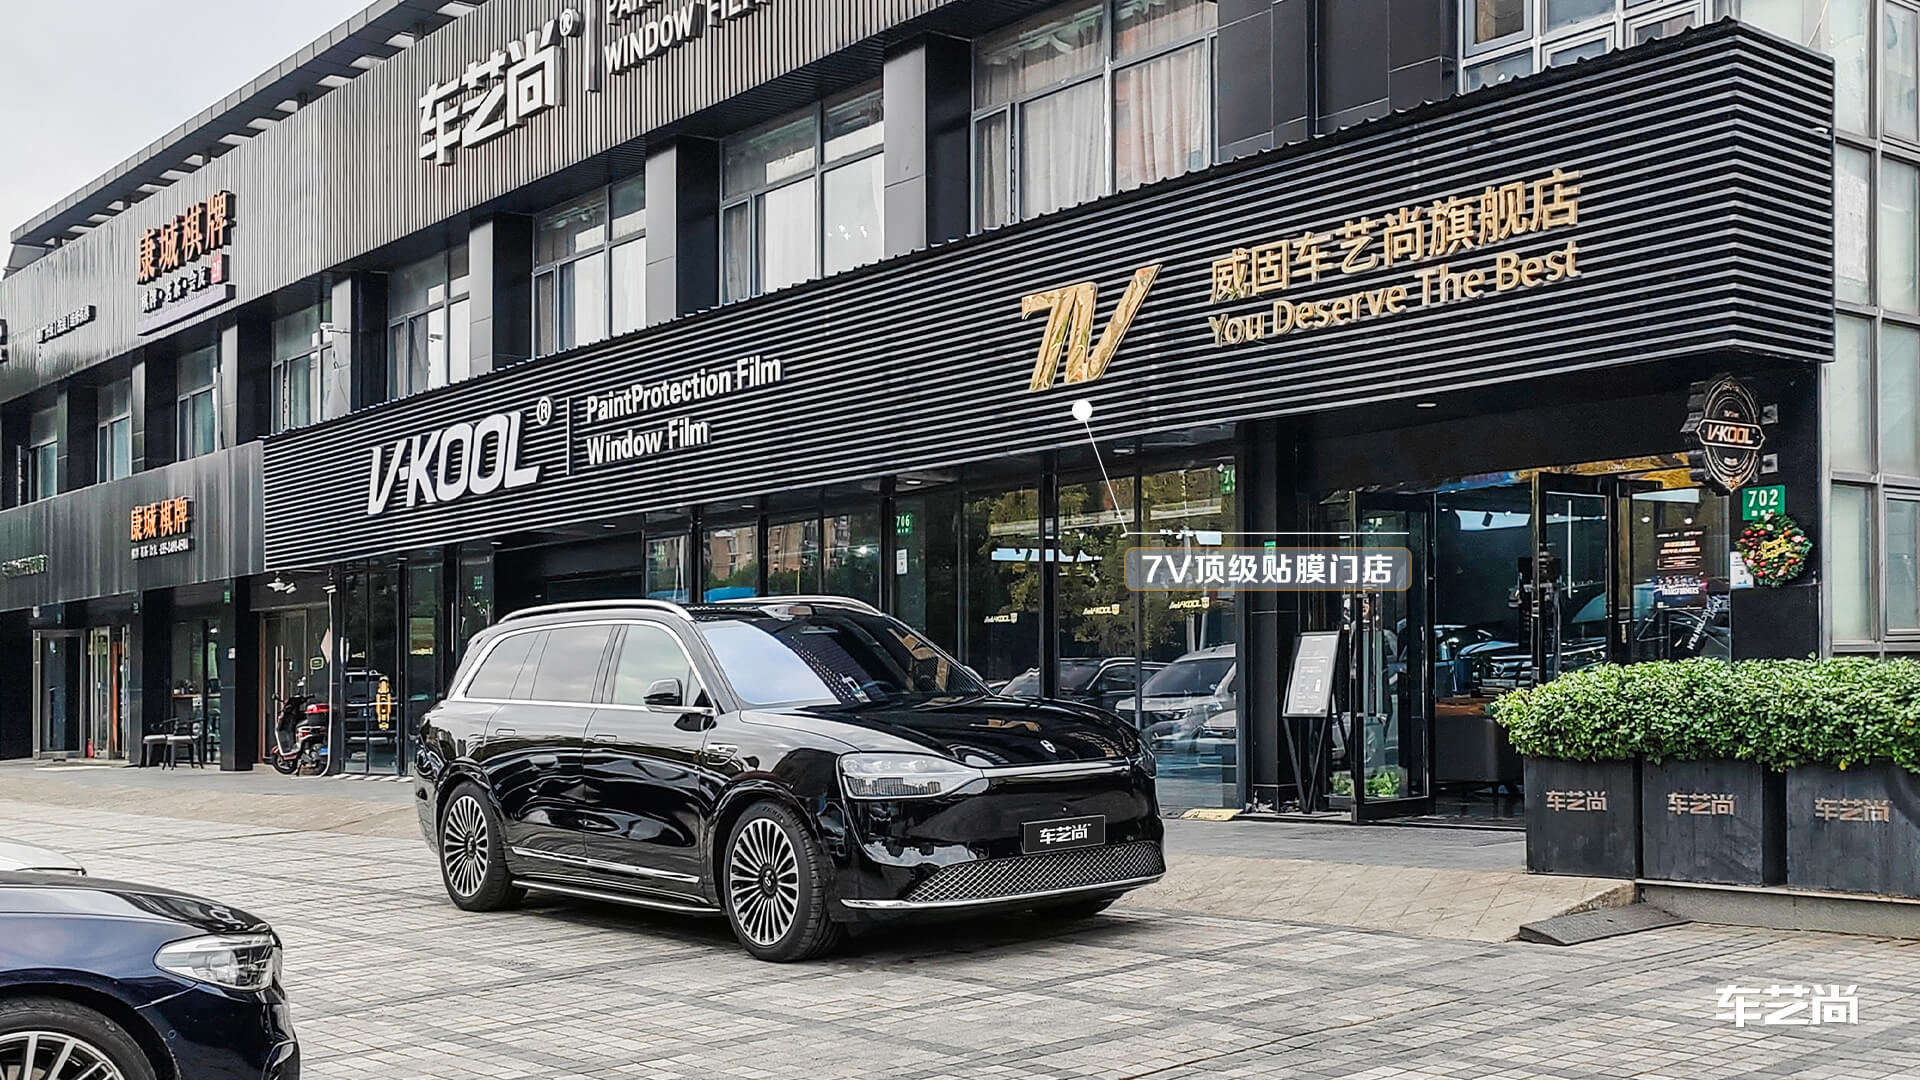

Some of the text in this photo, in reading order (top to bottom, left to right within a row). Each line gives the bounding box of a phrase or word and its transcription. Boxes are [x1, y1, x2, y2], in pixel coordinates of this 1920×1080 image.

[604, 1, 695, 73] WINDOW
[419, 20, 561, 166] 车艺尚
[138, 191, 228, 284] 康城棋牌
[1210, 168, 1583, 303] 威固车艺尚旗舰店
[1208, 240, 1581, 347] You Deserve The Best
[586, 355, 782, 423] PaintProtection Film
[586, 418, 711, 467] Window Film
[1707, 423, 1754, 445] V-KOOL
[367, 411, 540, 515] V-KOOL
[131, 496, 188, 541] 康城棋牌
[896, 514, 910, 528] 706
[1748, 488, 1778, 507] 702
[1546, 790, 1608, 812] 车艺尚
[1667, 792, 1736, 816] 车艺尚
[1814, 797, 1892, 823] 车艺尚
[1039, 824, 1089, 845] 车艺尚
